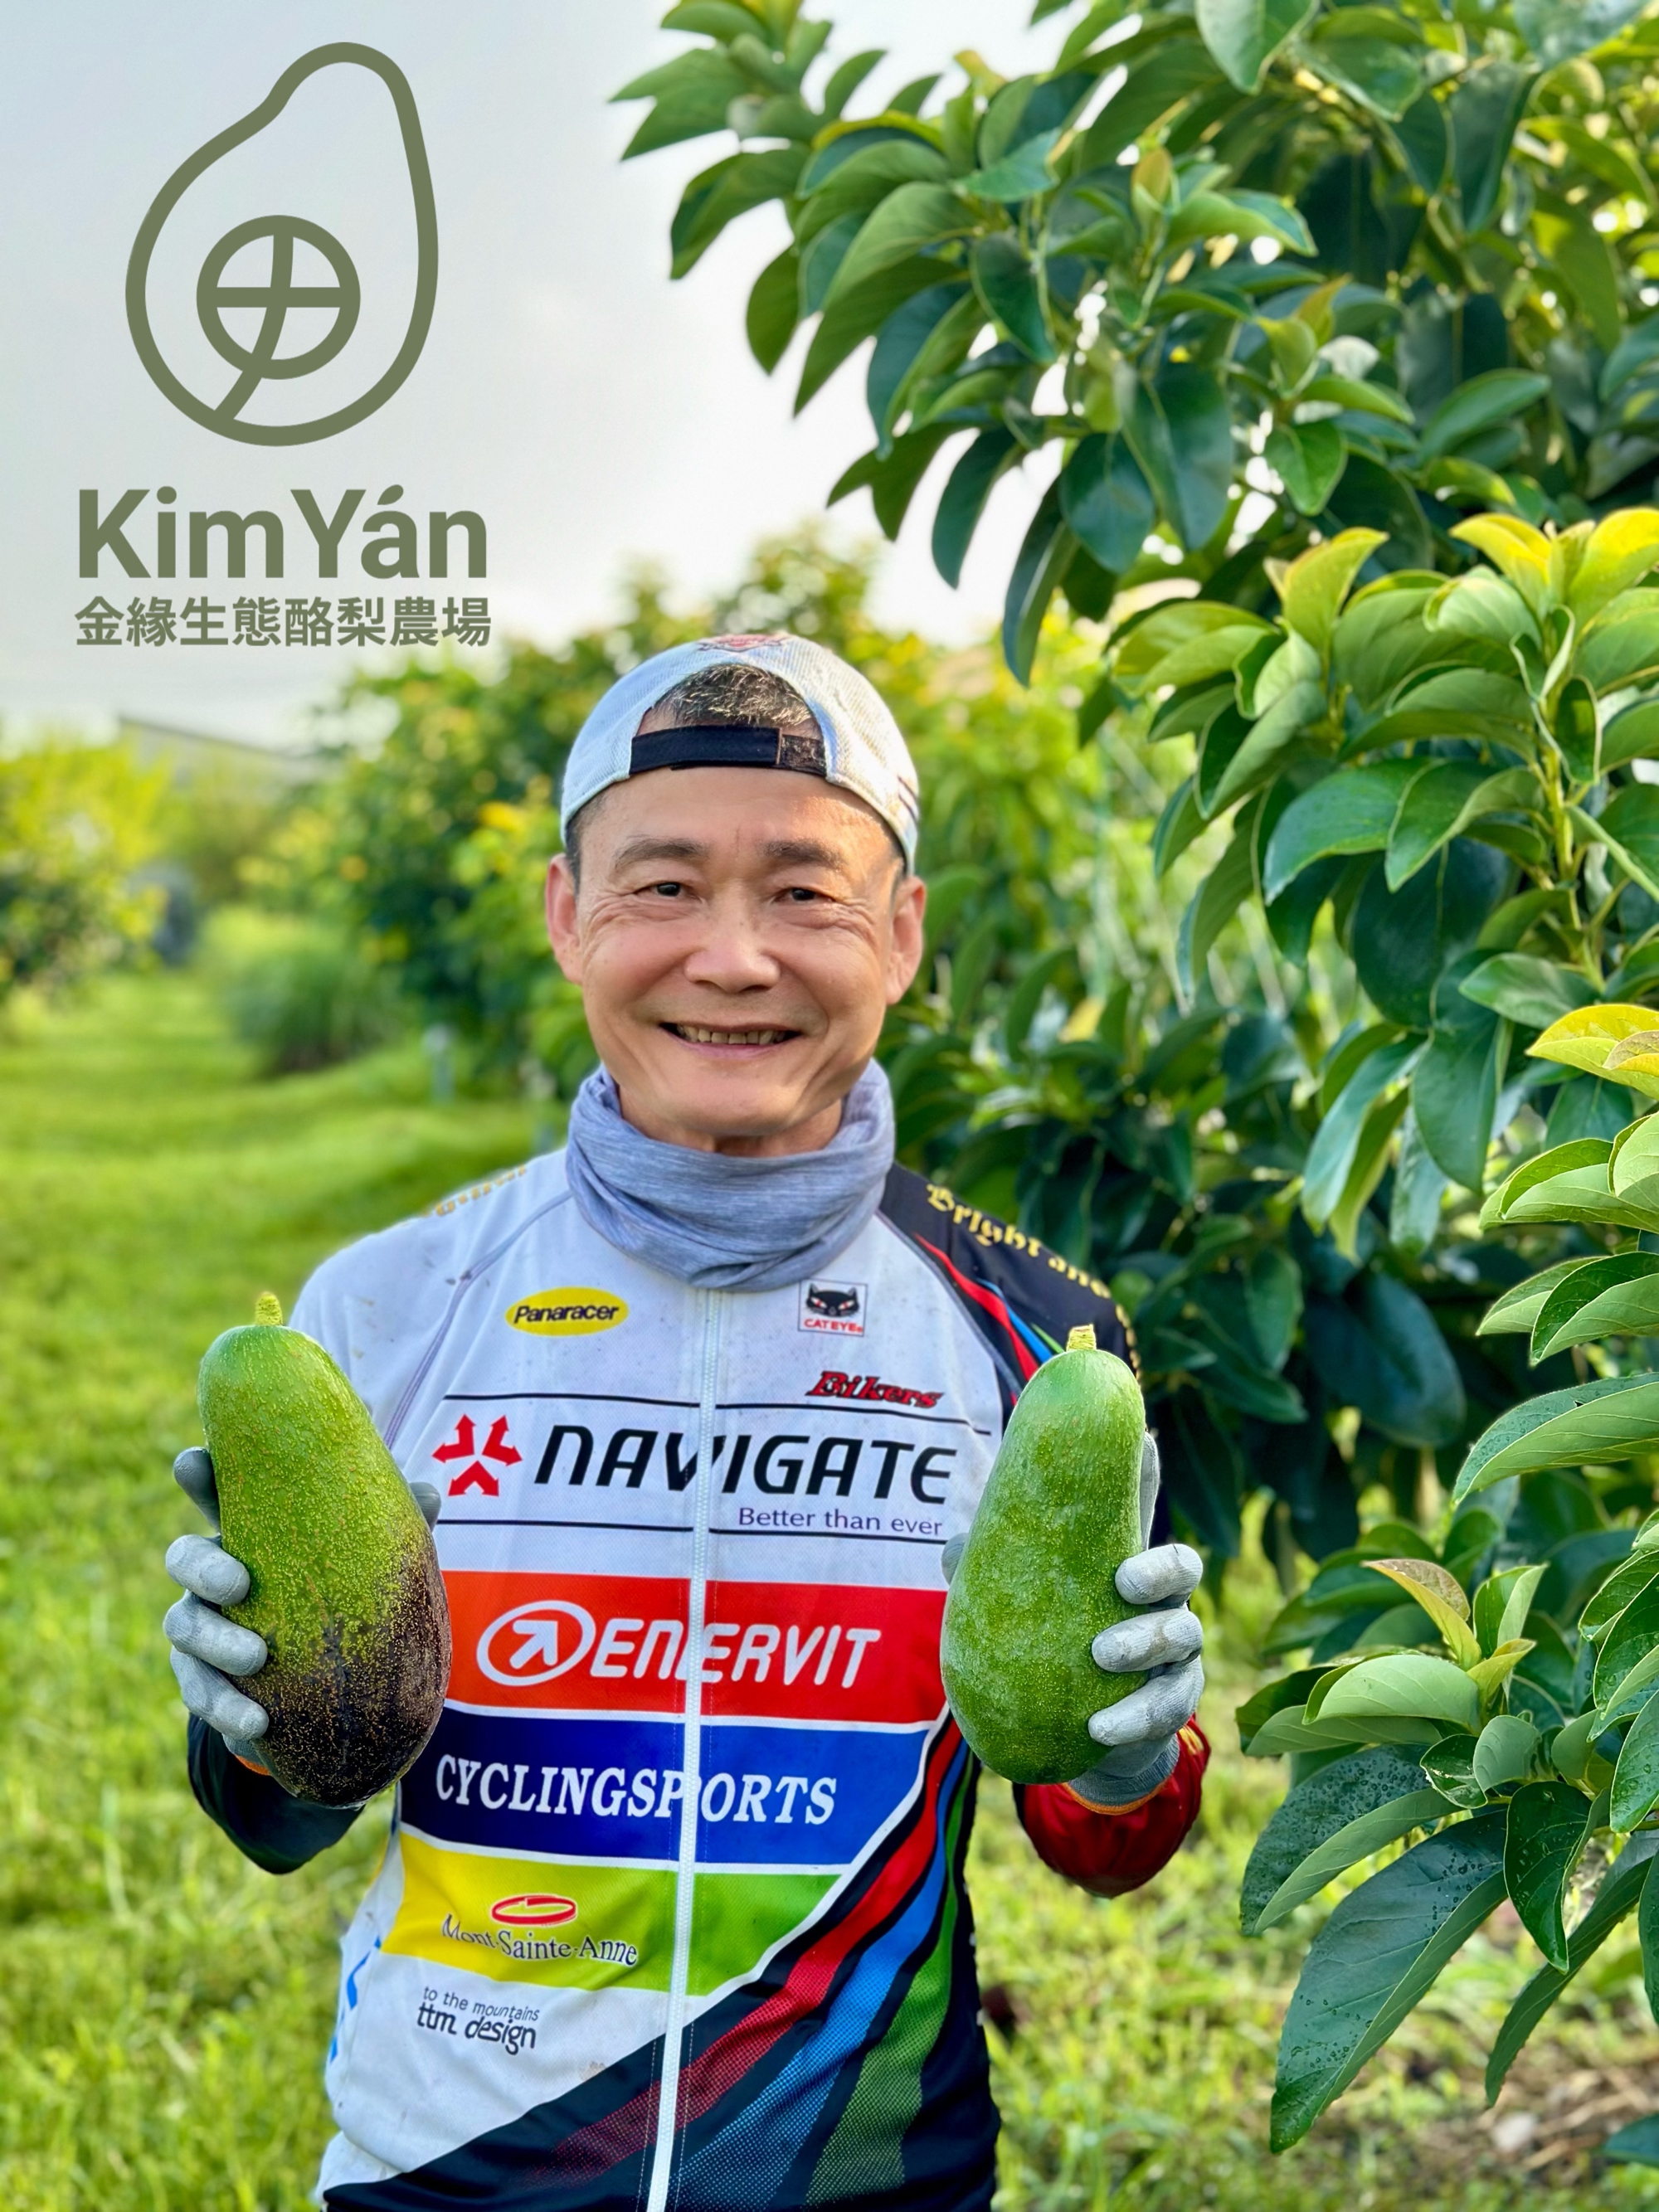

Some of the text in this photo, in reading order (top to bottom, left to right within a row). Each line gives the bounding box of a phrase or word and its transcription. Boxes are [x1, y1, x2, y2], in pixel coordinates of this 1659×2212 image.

[513, 1305, 619, 1325] Panaracer
[804, 1319, 859, 1332] CATEYE
[805, 1370, 945, 1408] Bikers
[534, 1424, 957, 1505] NAVIGATE
[738, 1507, 942, 1535] Better than ever
[590, 1618, 882, 1689] ENERVIT
[435, 1753, 837, 1825] CYCLINGSPORTS
[423, 1986, 540, 2021] to the mountains
[416, 2002, 537, 2055] ttm design
